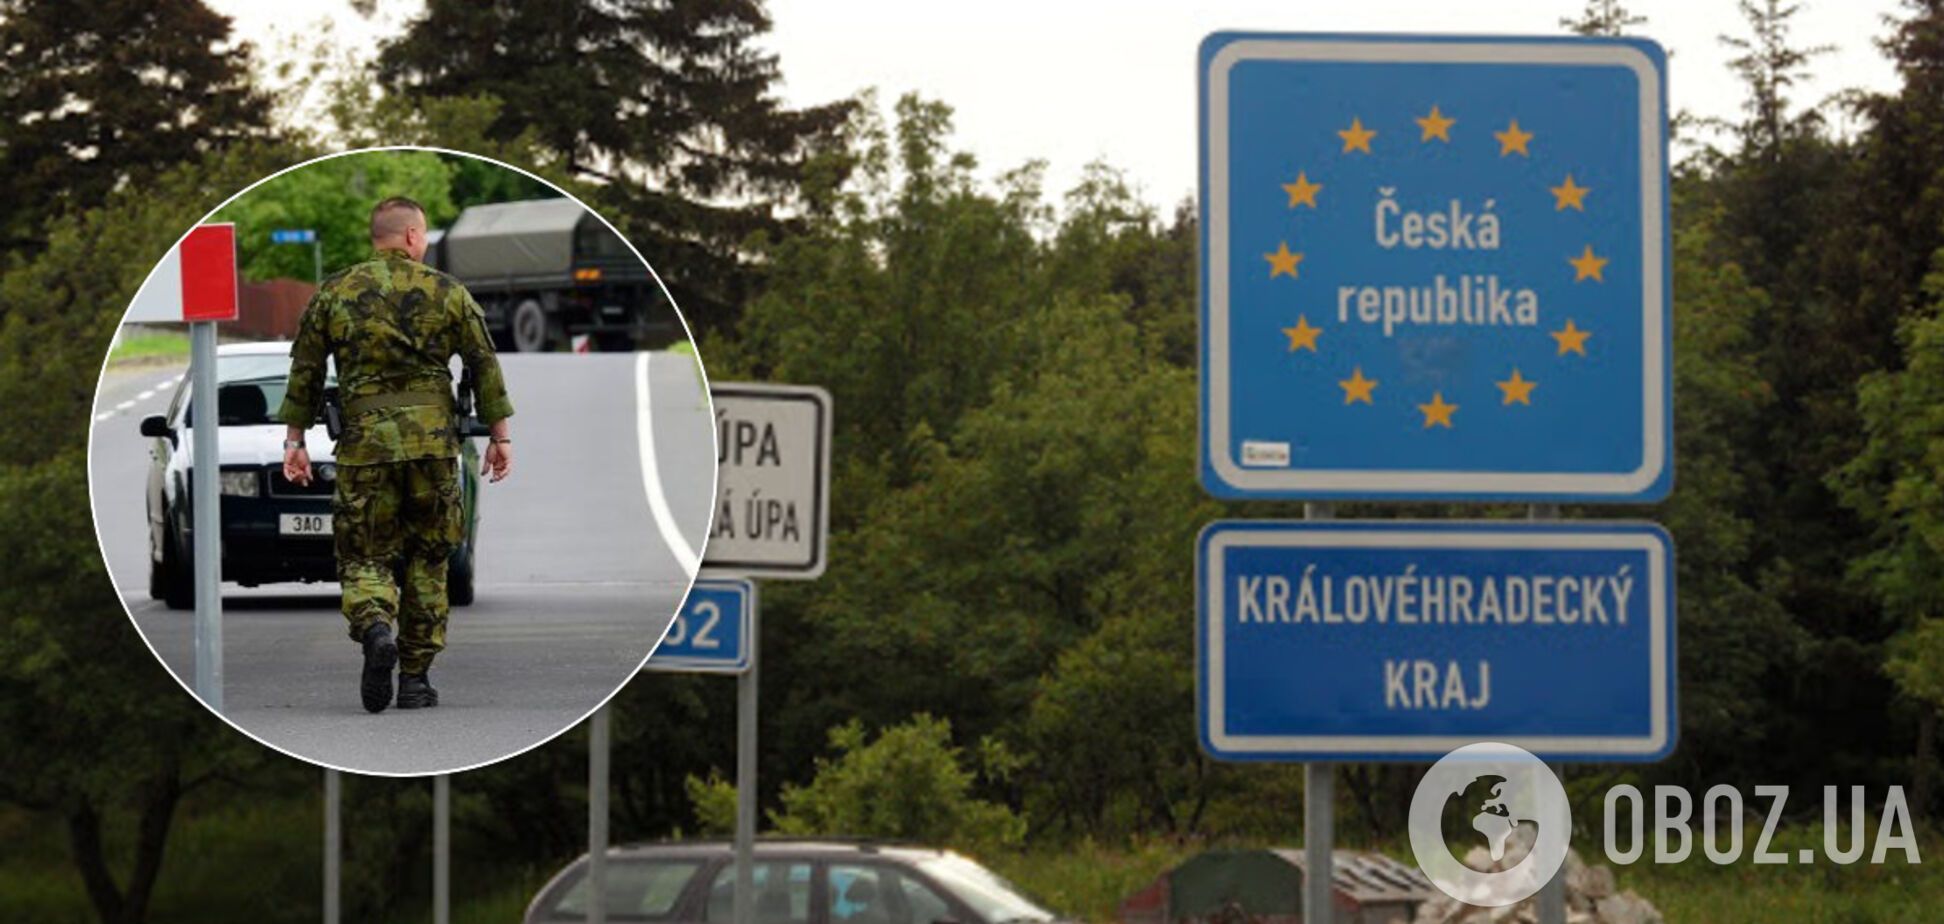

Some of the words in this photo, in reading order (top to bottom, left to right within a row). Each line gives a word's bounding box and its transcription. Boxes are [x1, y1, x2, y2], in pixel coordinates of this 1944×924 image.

[1375, 186, 1500, 249] Česká
[1337, 274, 1538, 337] republika
[745, 488, 800, 542] ÚPA
[1237, 564, 1633, 625] KRÁLOVÉHRADECKÝ
[1384, 660, 1491, 710] KRAJ
